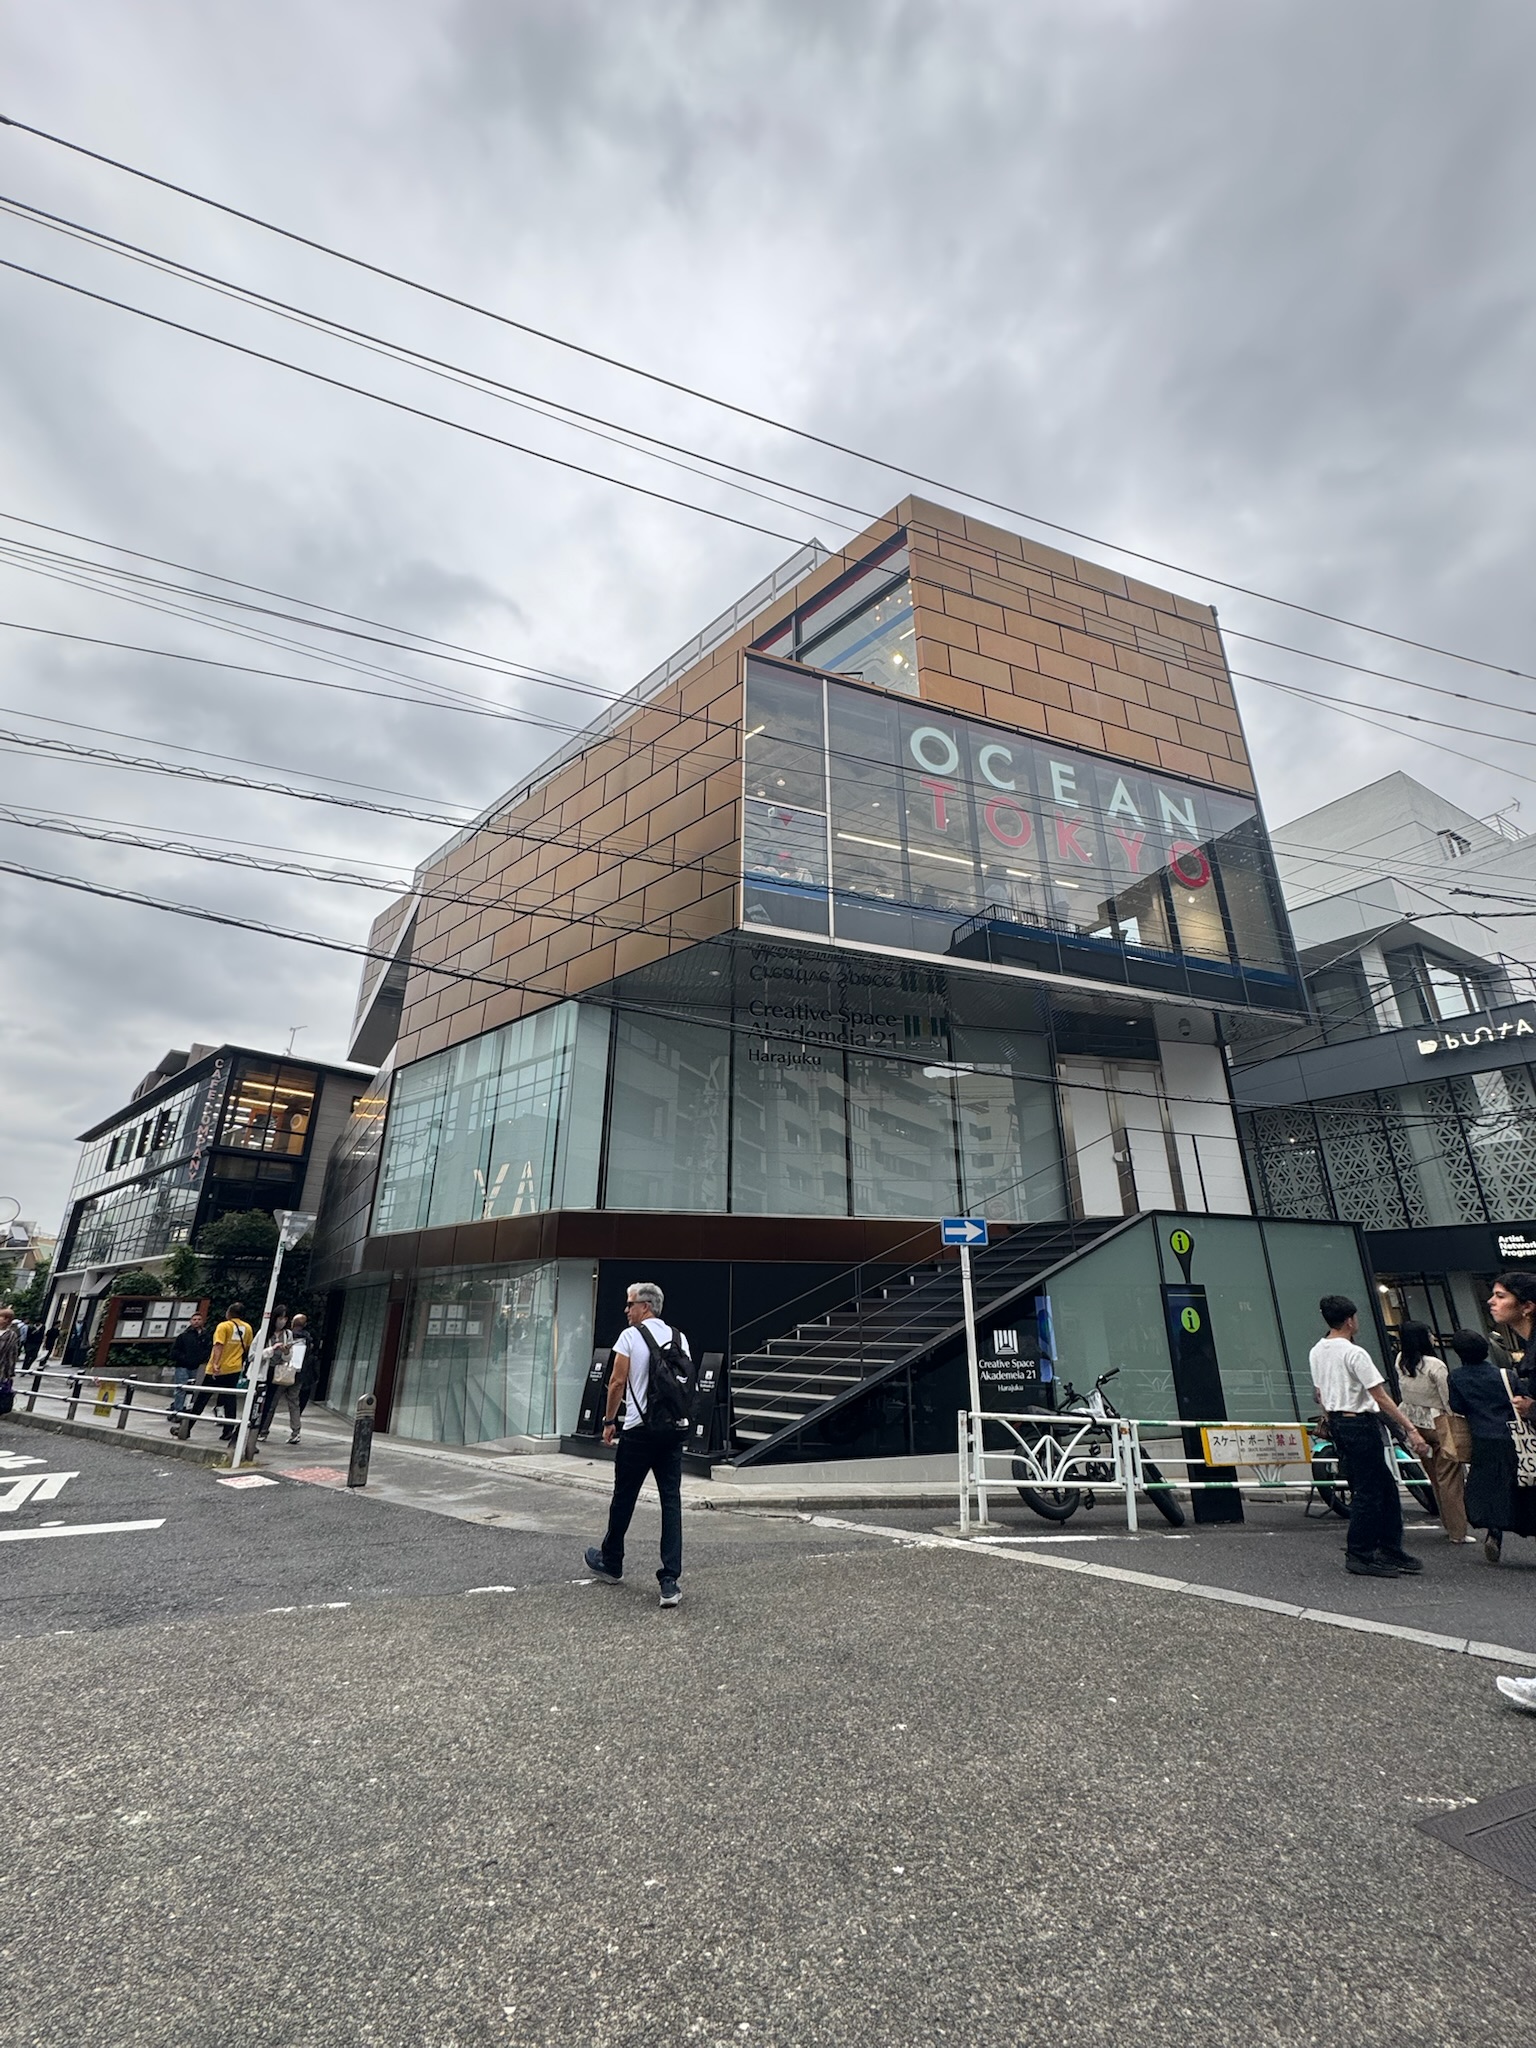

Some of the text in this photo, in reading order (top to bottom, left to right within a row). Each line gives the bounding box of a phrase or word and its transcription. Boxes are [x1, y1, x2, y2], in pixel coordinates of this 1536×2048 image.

[910, 726, 1200, 840] OCEAN
[920, 775, 1213, 889] TOKYO
[749, 1000, 898, 1028] Creative Space
[874, 1031, 898, 1049] 21
[748, 1049, 822, 1066] Harajuku
[188, 1058, 224, 1181] CAFE COMPANY
[1498, 1234, 1525, 1243] Artist
[978, 1358, 1035, 1369] Creative Space
[980, 1369, 1036, 1381] Akademeia 21
[997, 1384, 1024, 1392] Harajuku
